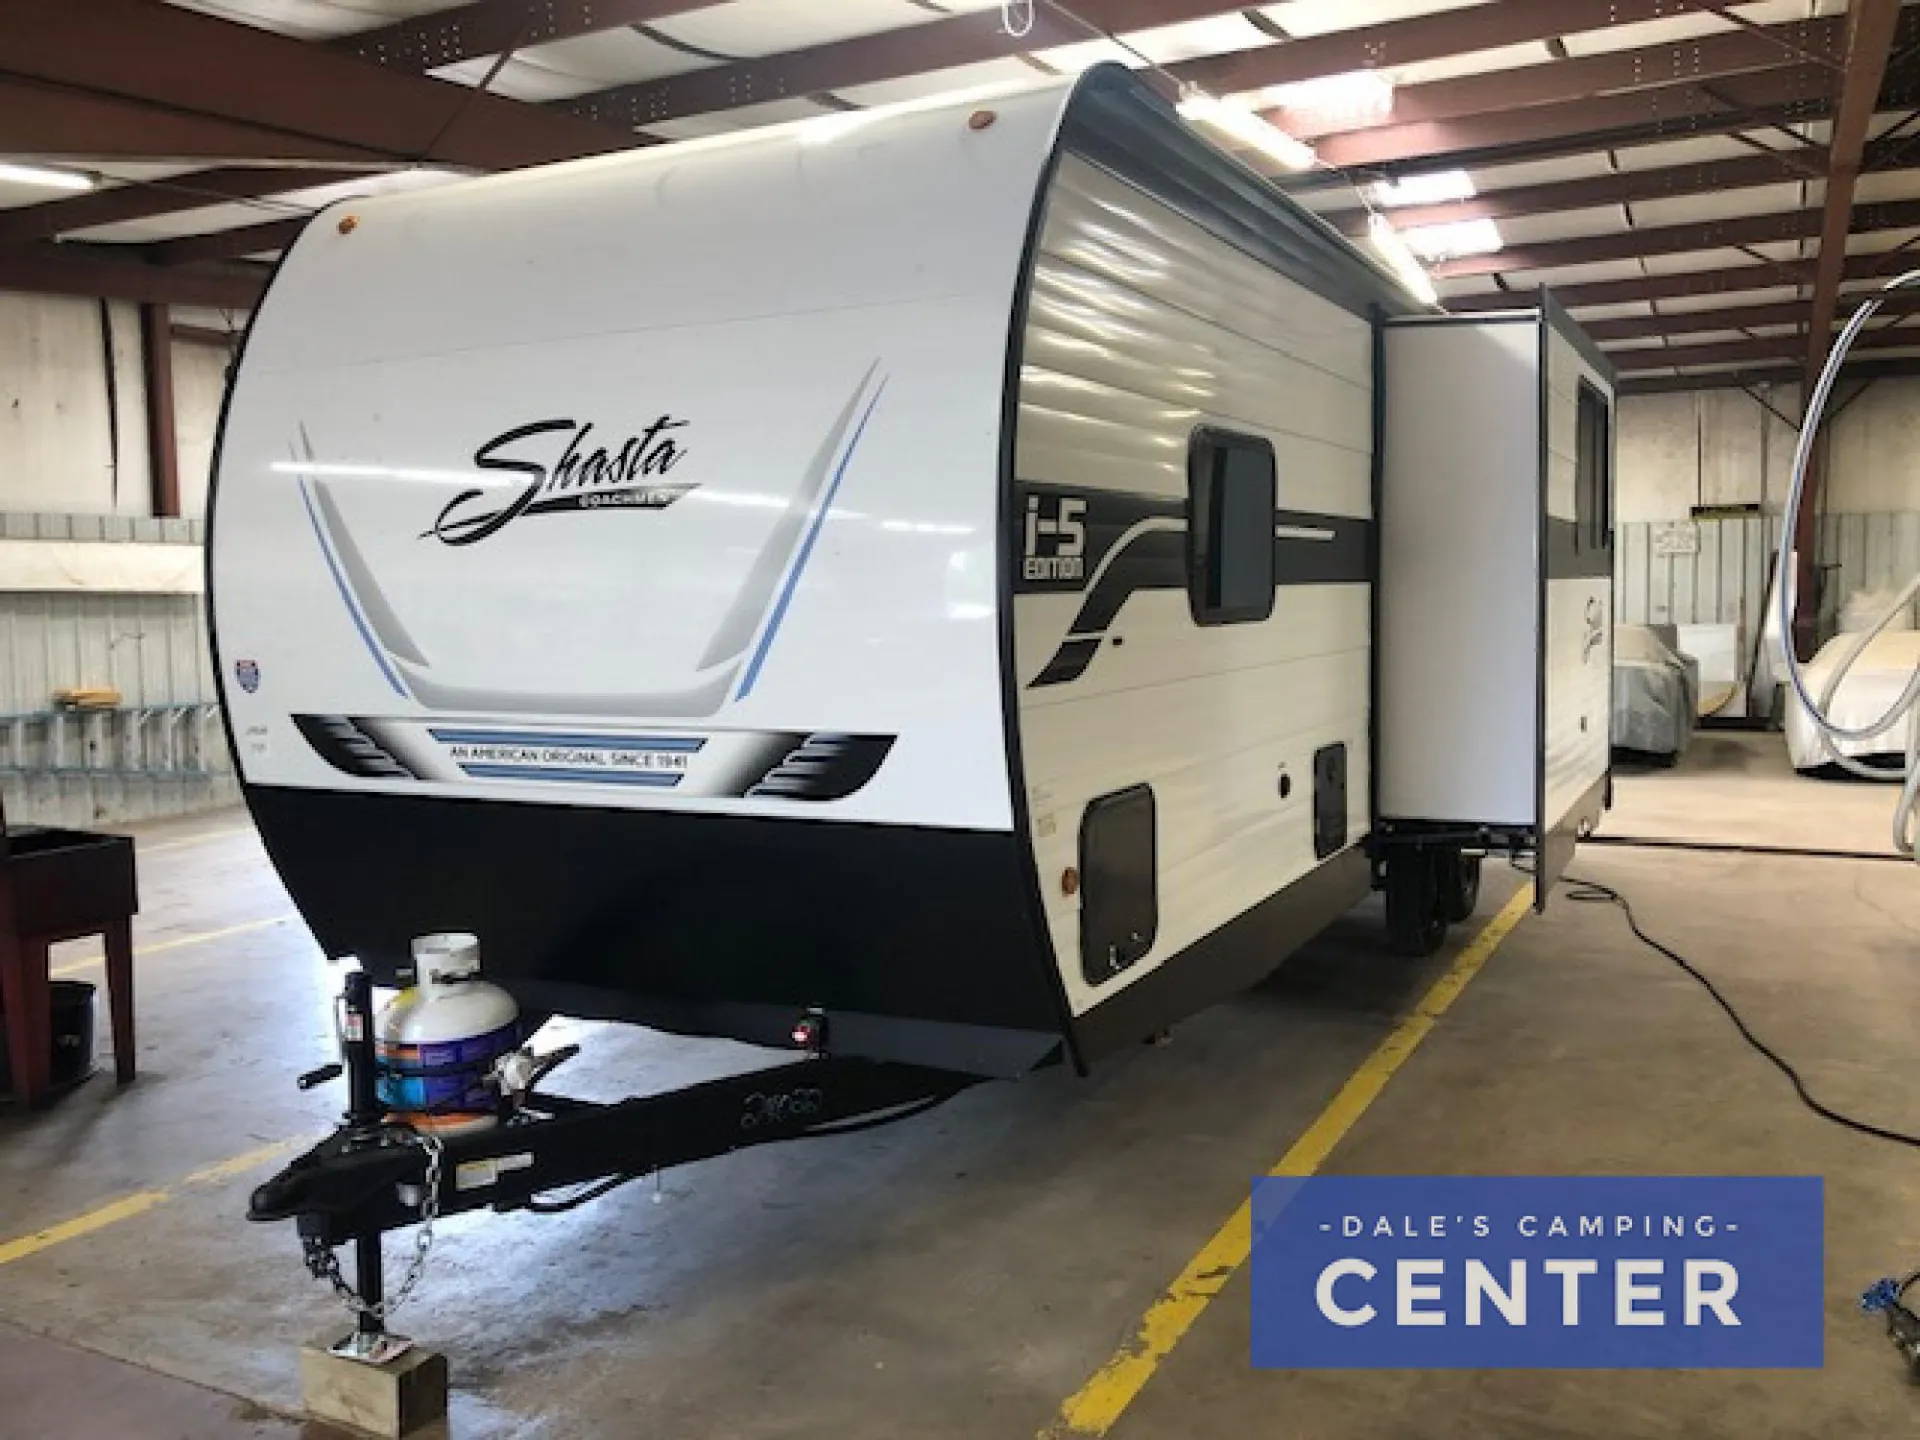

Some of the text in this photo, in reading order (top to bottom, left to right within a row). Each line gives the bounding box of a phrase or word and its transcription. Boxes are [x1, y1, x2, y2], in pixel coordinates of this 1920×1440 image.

[417, 414, 690, 546] Shasta
[1025, 494, 1087, 556] i-5
[451, 746, 467, 758] AN
[471, 747, 538, 760] AMERICAN
[543, 750, 606, 764] ORIGINAL
[612, 753, 653, 767] SINCE
